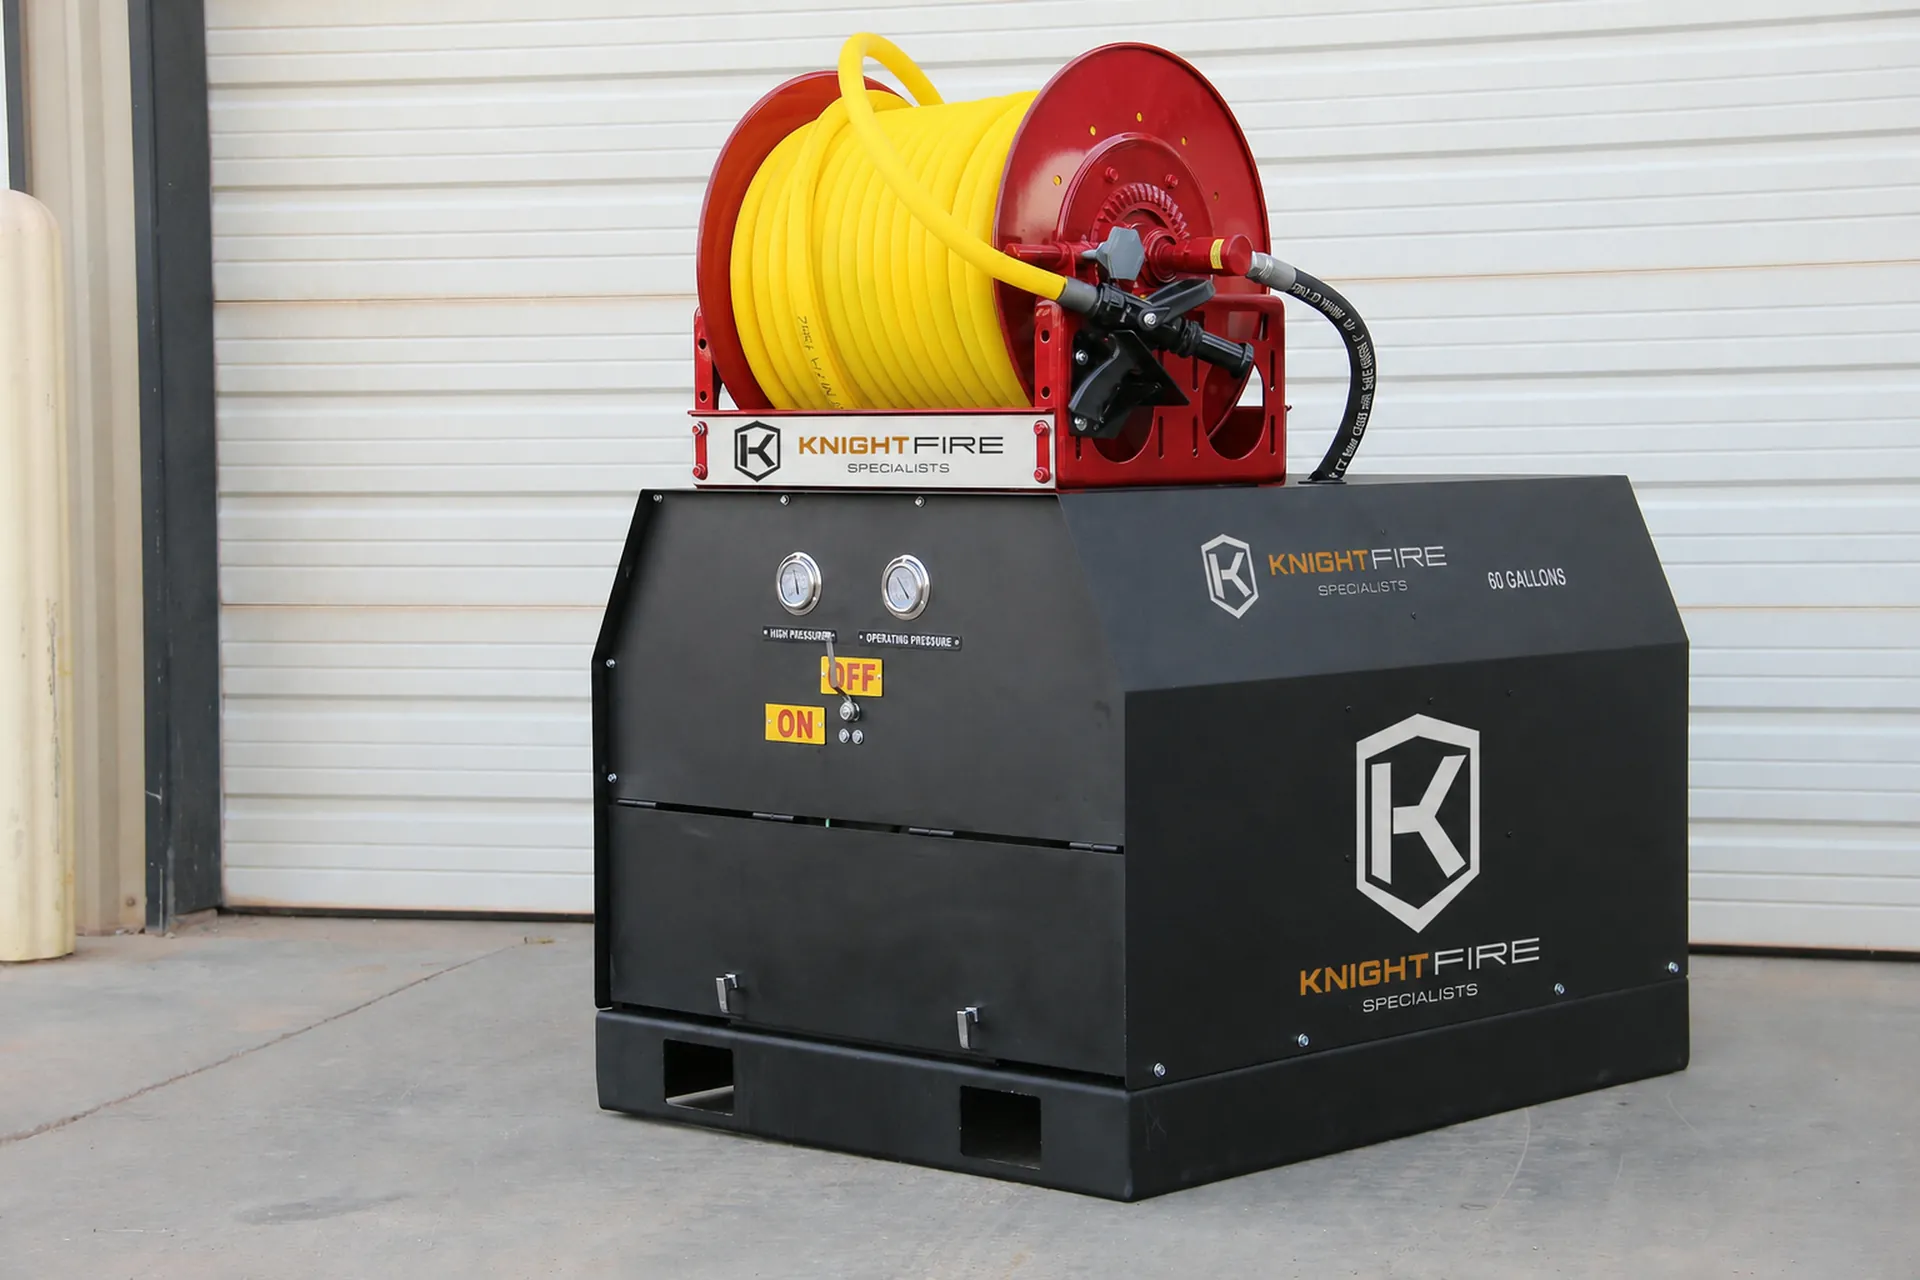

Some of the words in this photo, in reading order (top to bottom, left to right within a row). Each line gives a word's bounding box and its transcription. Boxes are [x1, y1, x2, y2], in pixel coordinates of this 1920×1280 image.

[847, 463, 950, 474] SPECIALISTS
[1318, 580, 1408, 597] SPECIALISTS
[1488, 571, 1504, 590] 60
[1506, 568, 1567, 588] GALLONS
[770, 629, 788, 639] HIGH
[866, 633, 908, 645] OPERATING
[910, 635, 952, 647] PRESSURE
[828, 662, 876, 692] OFF
[777, 708, 813, 739] ON
[1371, 754, 1467, 885] K
[1363, 983, 1478, 1013] SPECIALISTS
